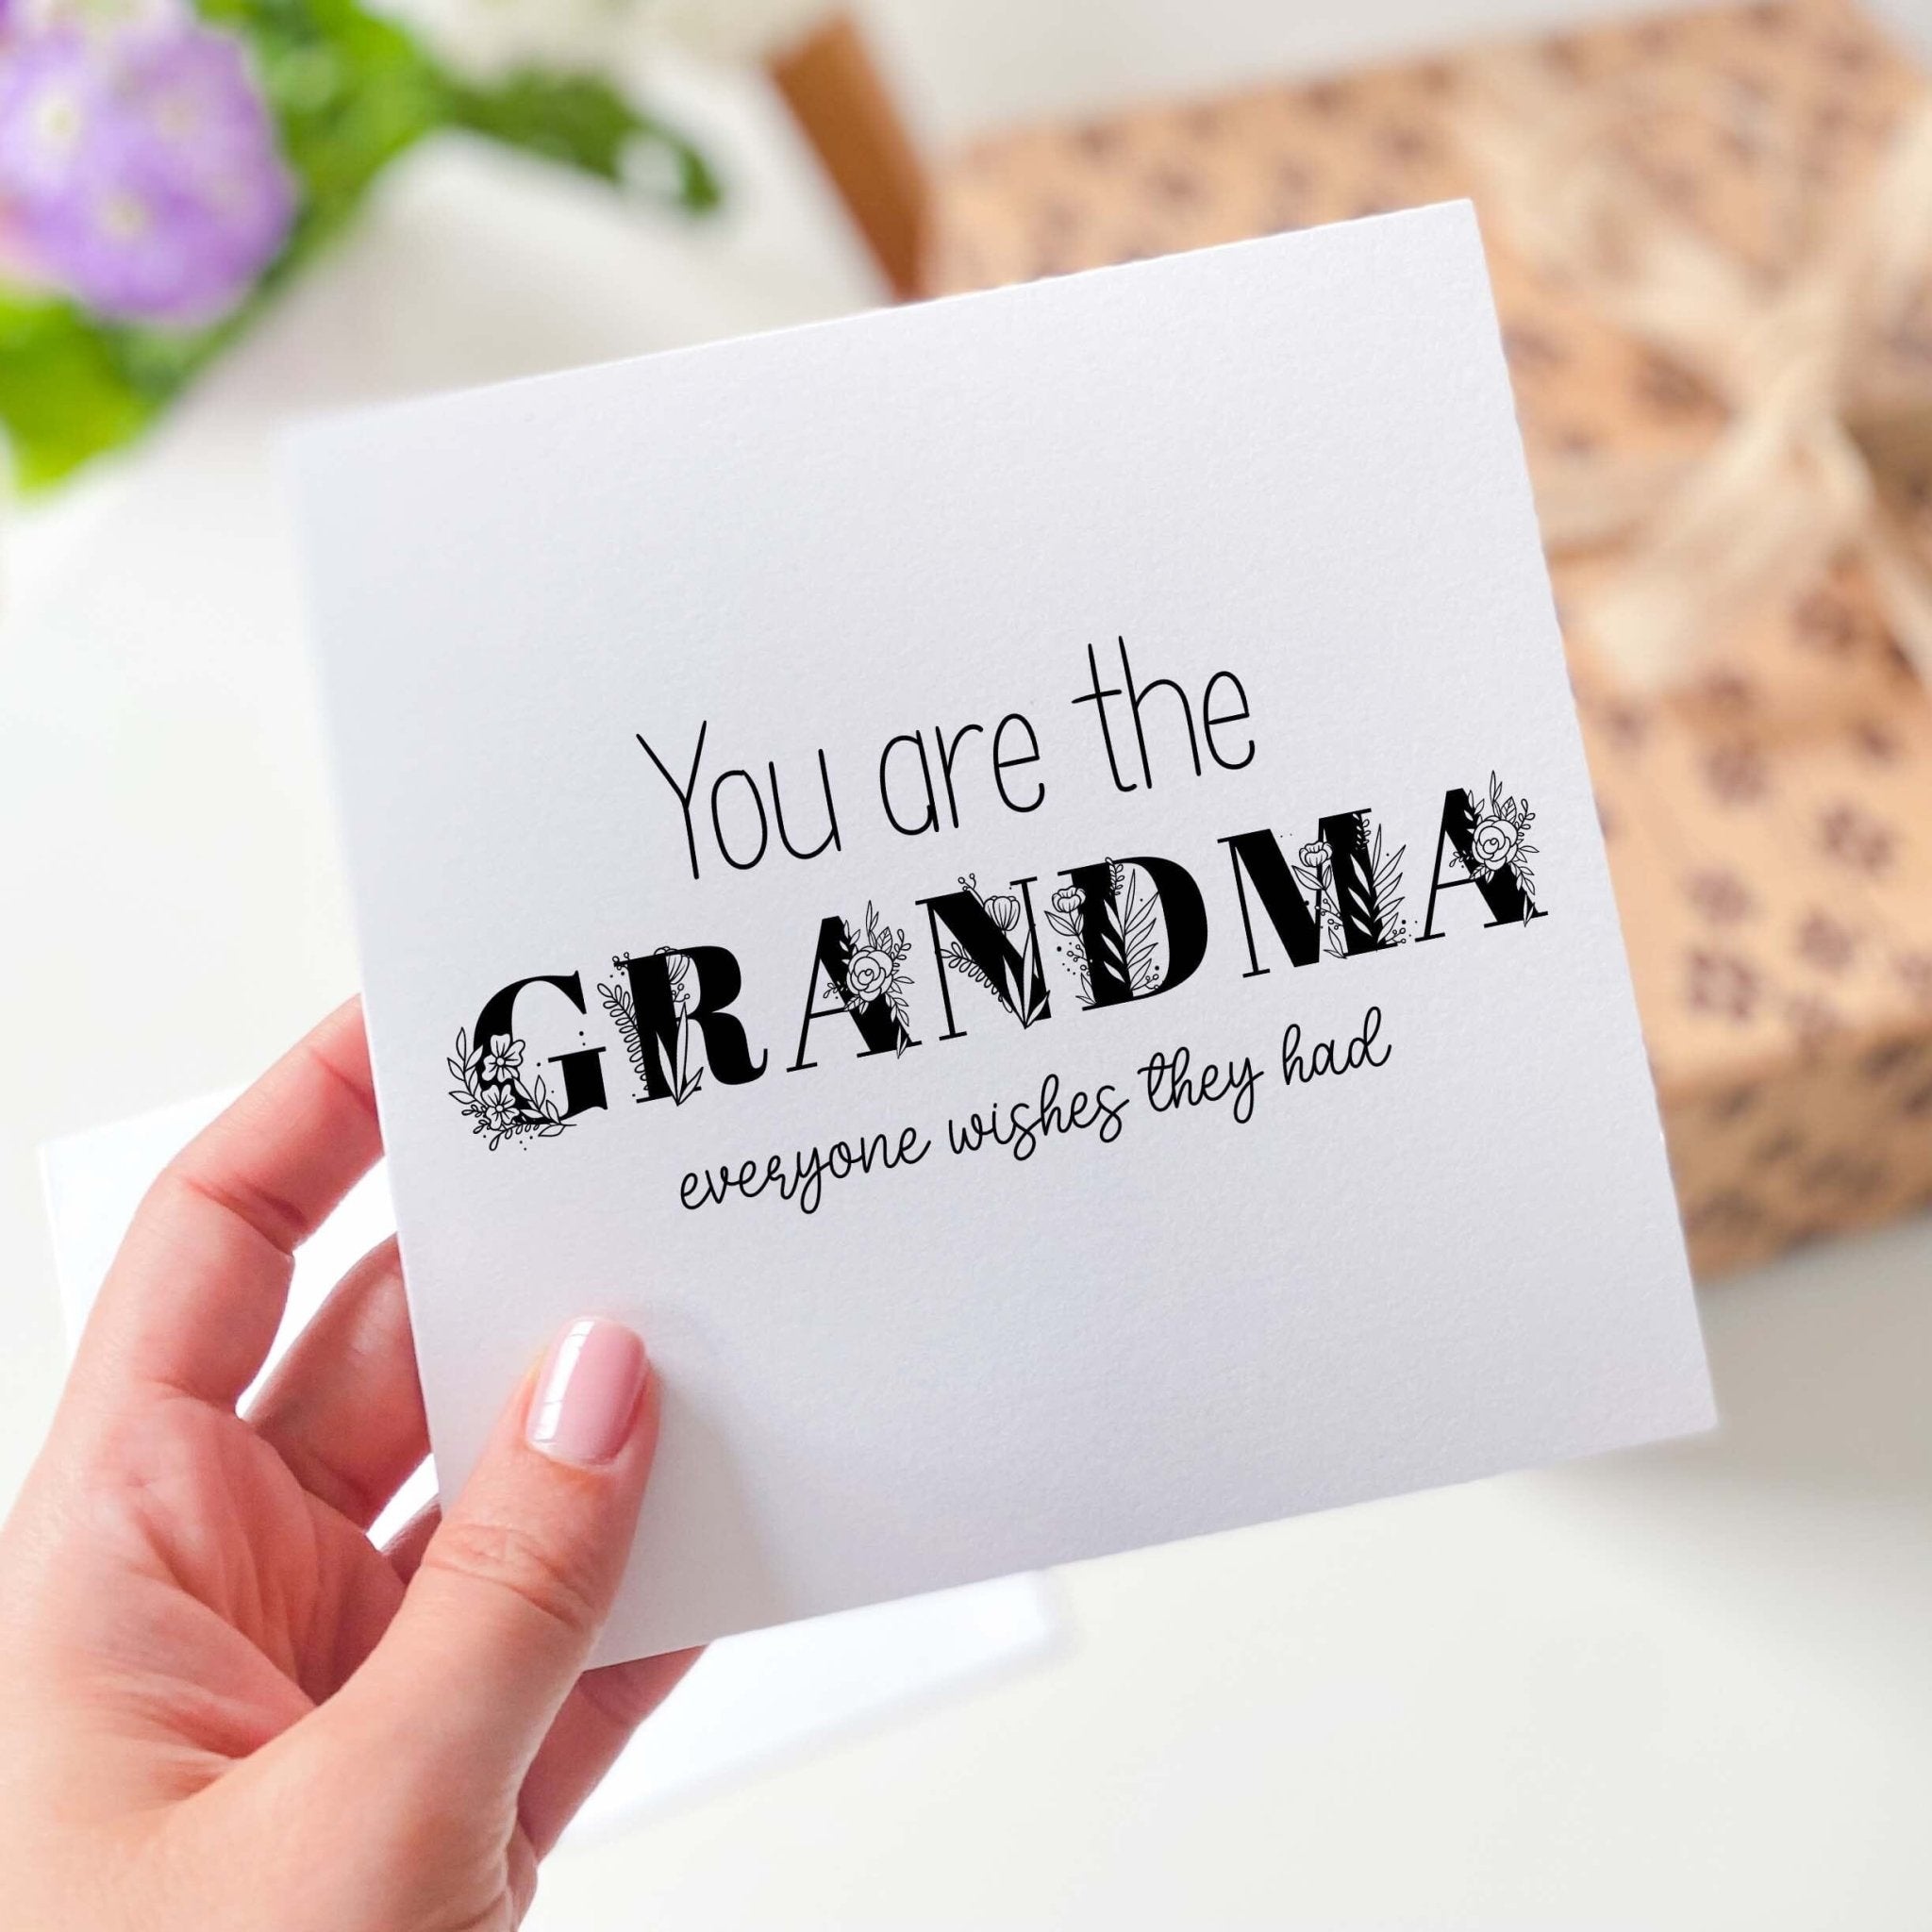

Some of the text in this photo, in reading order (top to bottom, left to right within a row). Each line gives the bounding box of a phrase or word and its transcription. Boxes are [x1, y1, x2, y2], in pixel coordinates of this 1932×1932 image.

[636, 636, 1255, 879] You are the
[447, 771, 1548, 1151] GRANDMA
[681, 1007, 1391, 1214] everyone wishes they had
